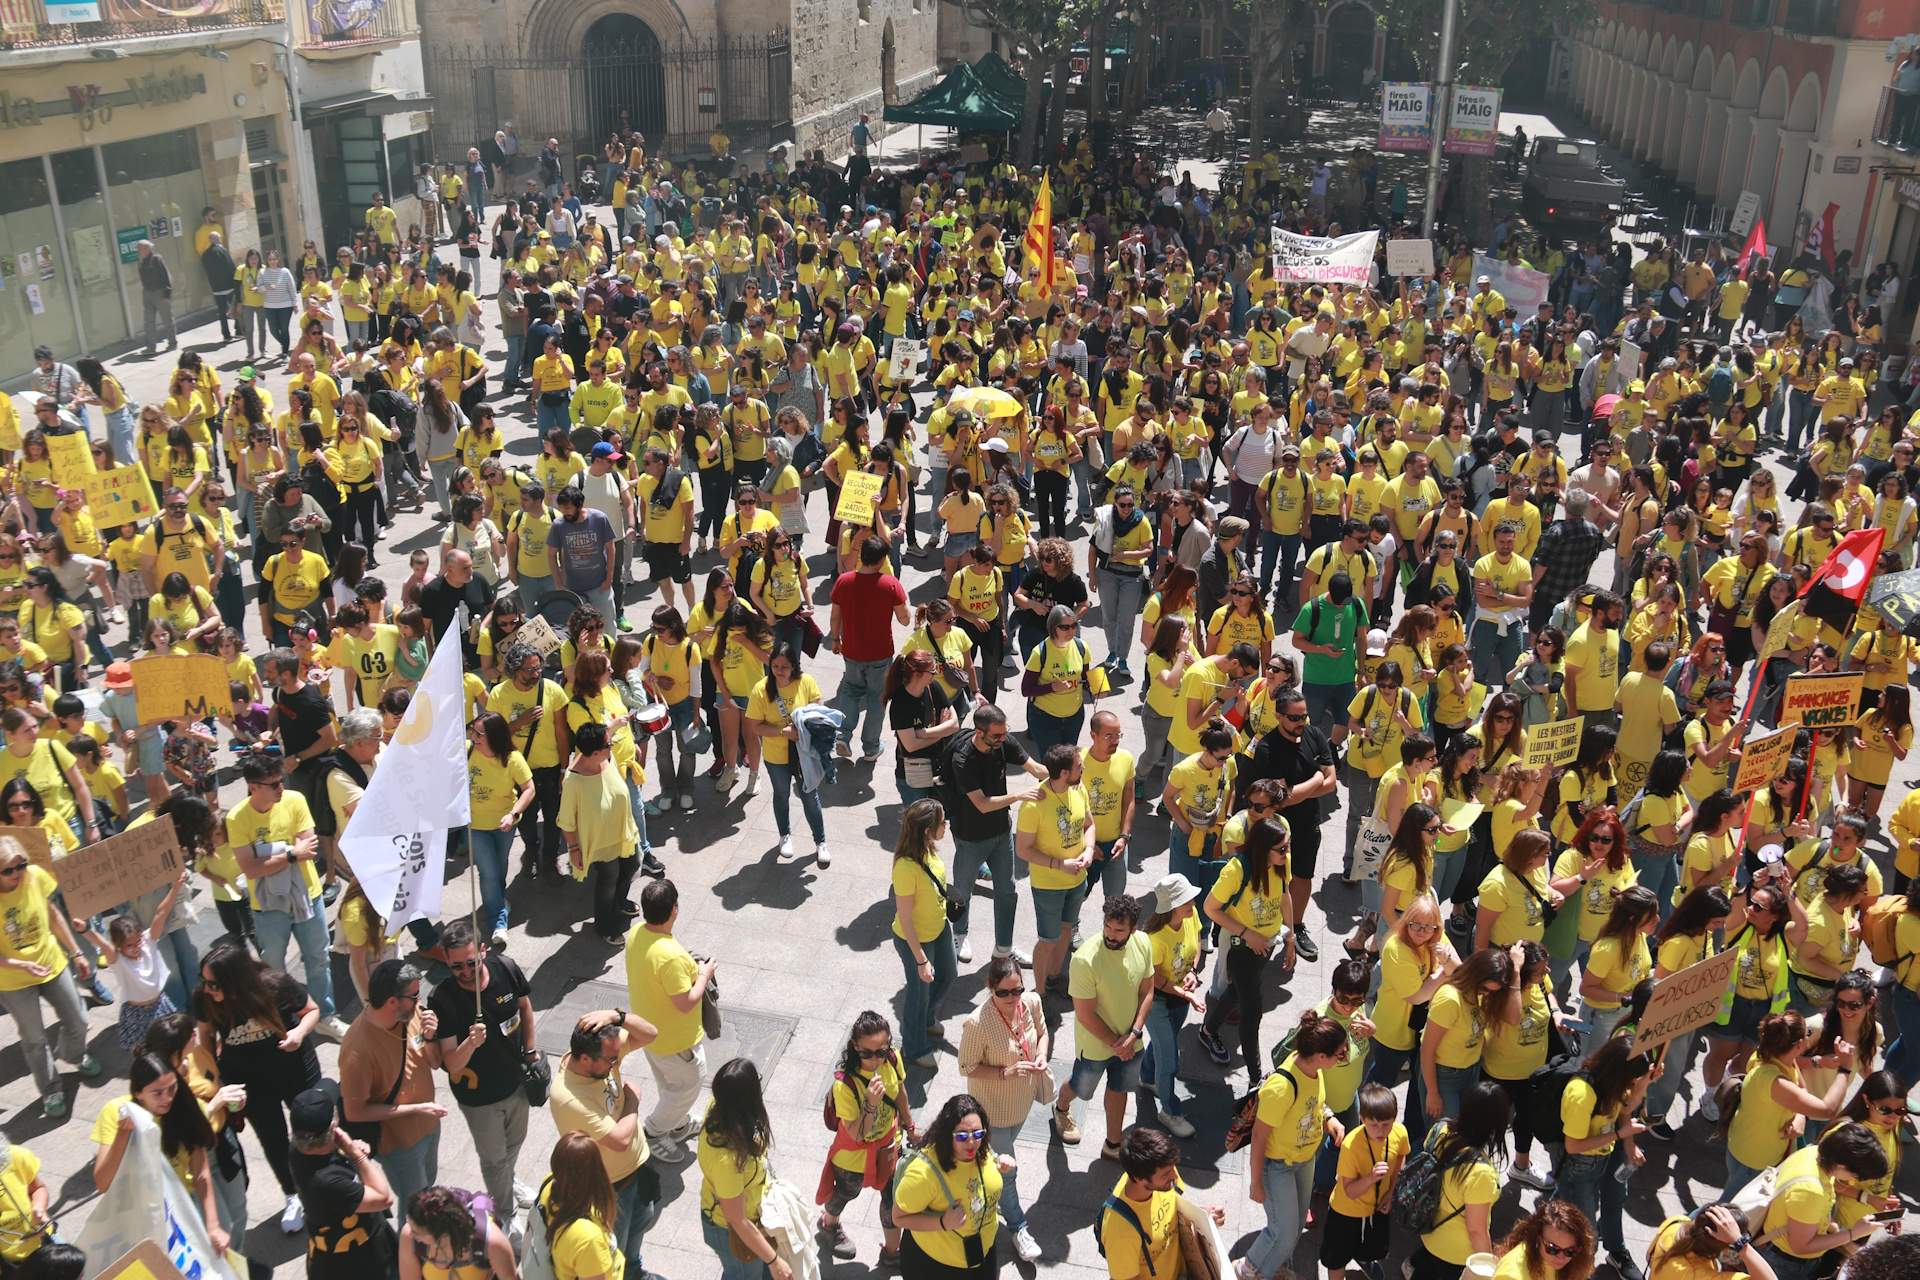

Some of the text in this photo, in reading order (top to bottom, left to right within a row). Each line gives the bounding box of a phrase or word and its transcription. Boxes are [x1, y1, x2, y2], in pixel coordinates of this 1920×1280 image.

[1388, 100, 1423, 112] MAIG
[1457, 104, 1492, 117] MAIG
[1272, 244, 1311, 258] SENSE
[1276, 256, 1331, 267] RECURSOS
[847, 479, 878, 491] RECURSOS
[1537, 723, 1577, 738] LES MESTRES
[1529, 754, 1552, 764] ESTEM
